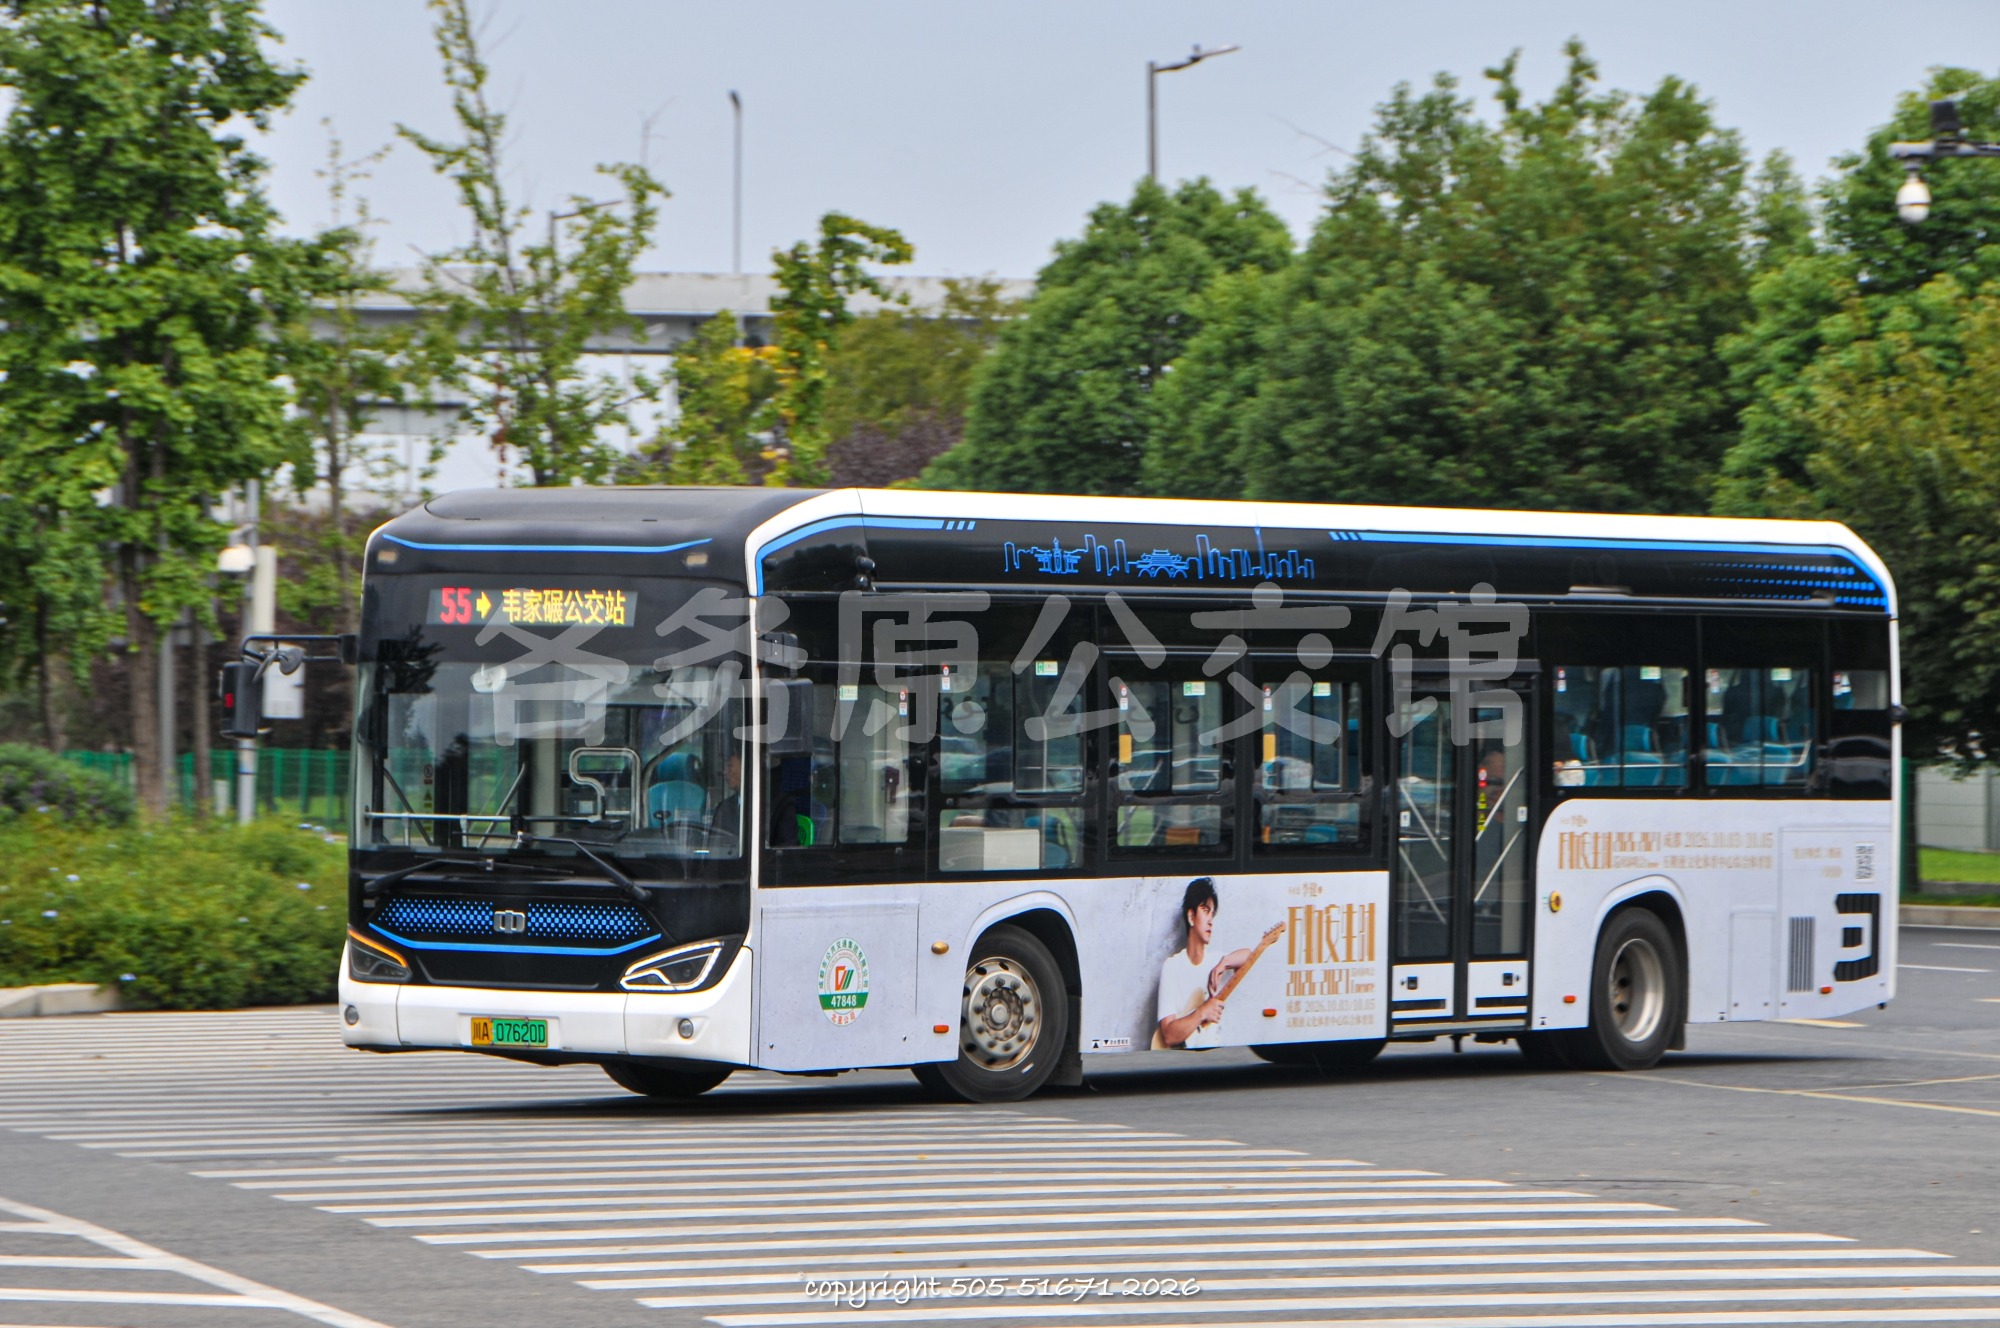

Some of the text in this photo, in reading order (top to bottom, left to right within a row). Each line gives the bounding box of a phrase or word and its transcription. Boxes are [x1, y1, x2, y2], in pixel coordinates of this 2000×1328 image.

[440, 587, 625, 625] 55 韦家碾公交站
[831, 995, 857, 1008] 47848
